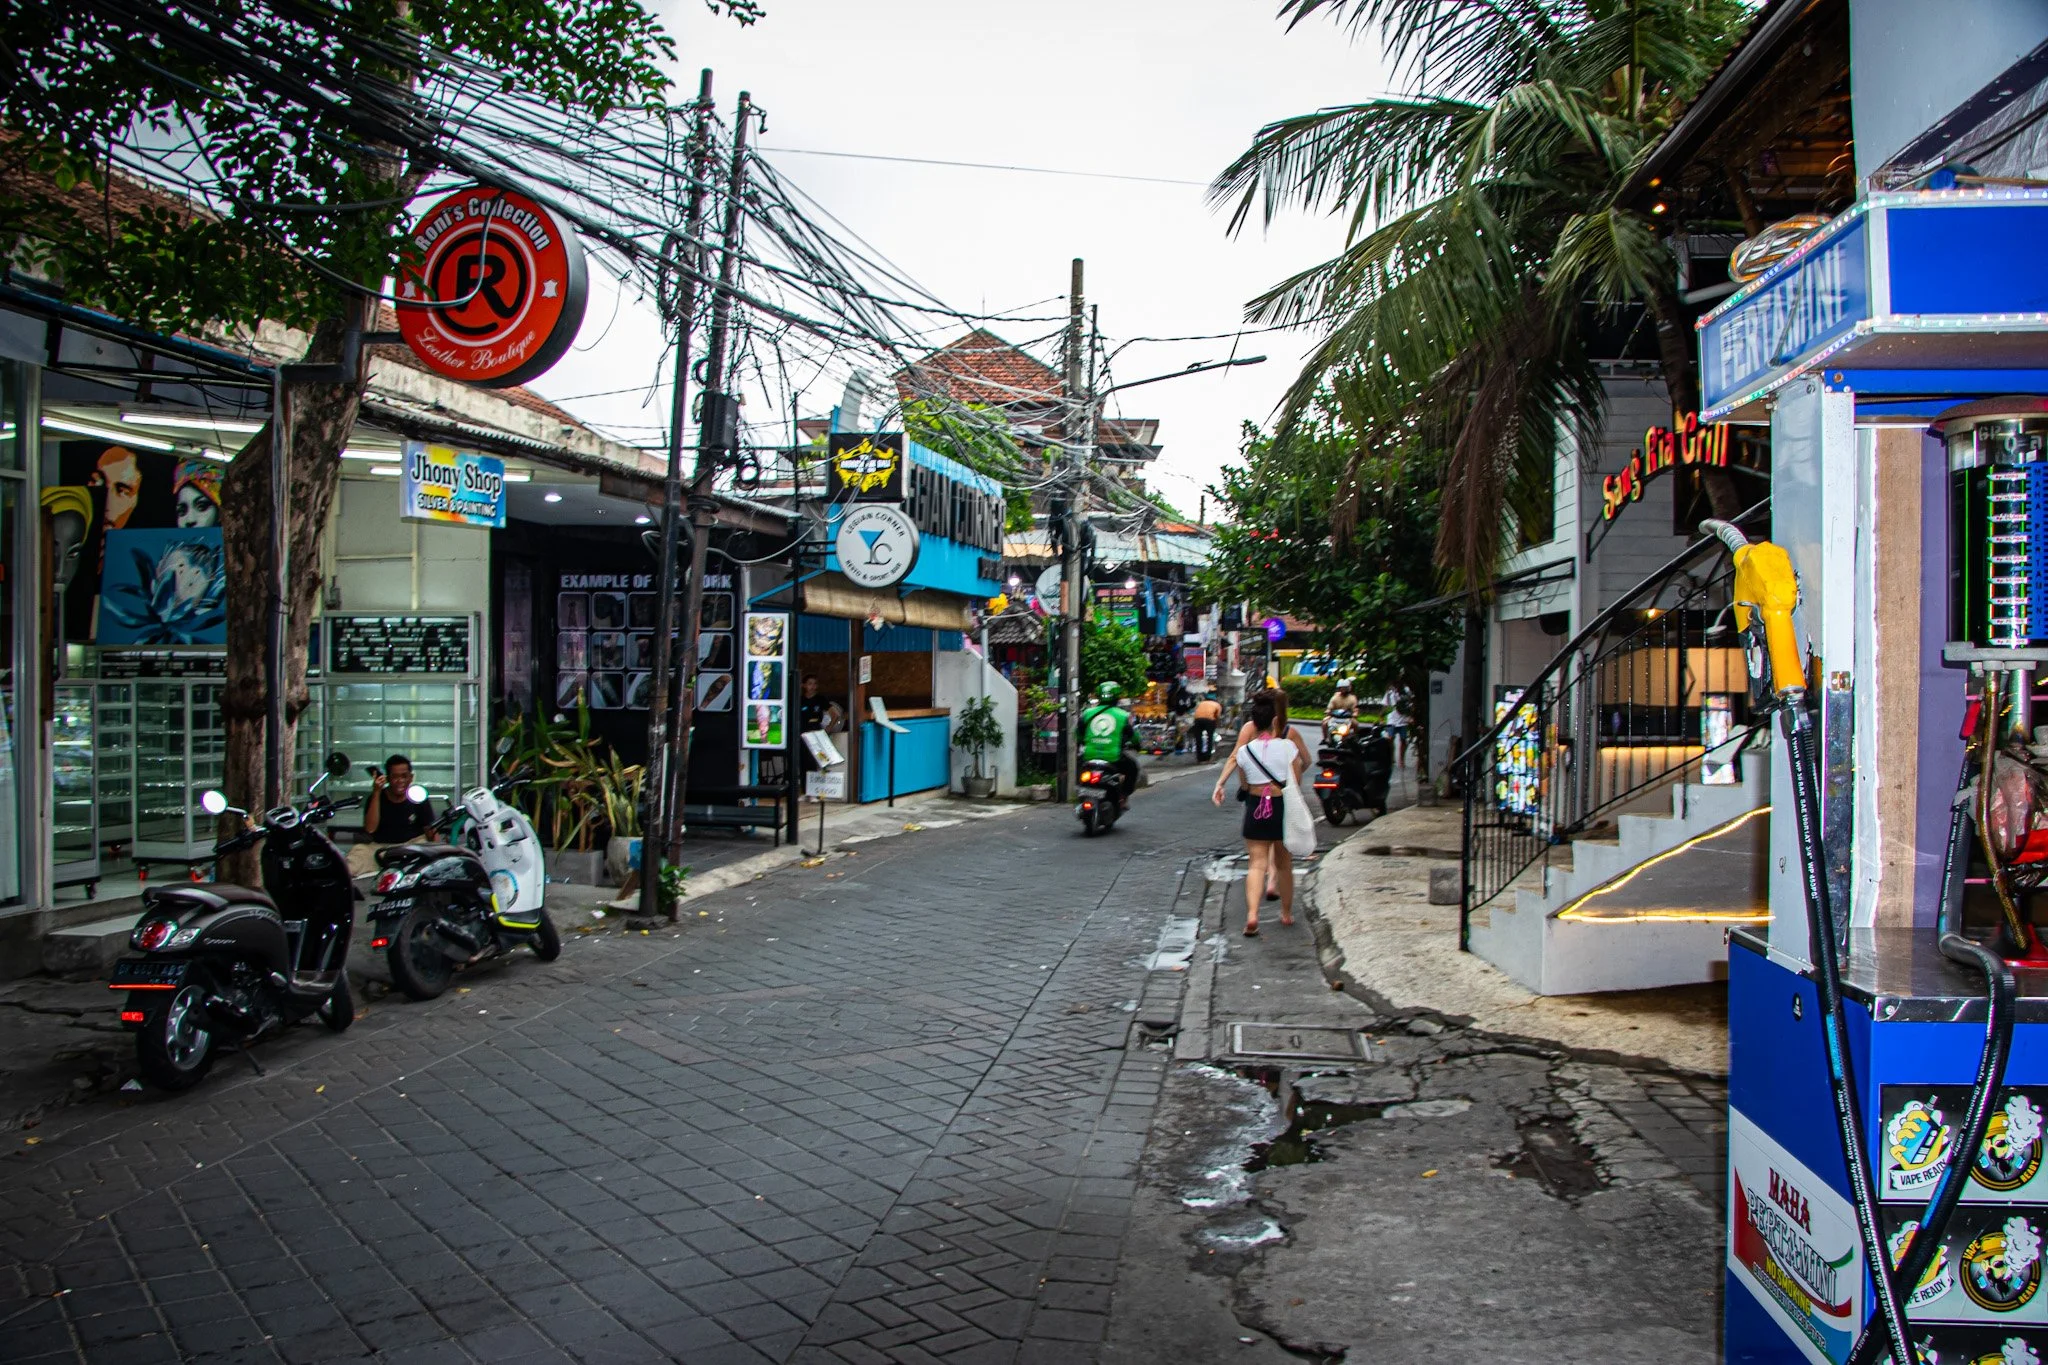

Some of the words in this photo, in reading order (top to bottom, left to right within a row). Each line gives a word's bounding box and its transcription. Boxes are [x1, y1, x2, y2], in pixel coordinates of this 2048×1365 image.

[415, 203, 465, 252] Roni's
[416, 326, 466, 369] Leather
[470, 330, 536, 371] Boutique
[1681, 411, 1730, 468] Grill
[412, 453, 461, 494] Jhony
[464, 463, 501, 501] Shop
[417, 493, 449, 511] SILVER
[457, 499, 497, 517] PAINTING
[875, 512, 906, 538] CORNER
[560, 574, 630, 588] EXAMPLE
[632, 574, 652, 588] OF
[1797, 781, 1806, 796] BAR
[1799, 799, 1808, 814] SAE
[1953, 1132, 1965, 1157] Japan
[1962, 1085, 1981, 1130] Technology
[1900, 1171, 1922, 1186] VAPE
[1923, 1158, 1948, 1182] READY
[2019, 1159, 2040, 1184] READY
[1768, 1167, 1812, 1235] MAHA
[1837, 1089, 1846, 1113] Japan
[1842, 1115, 1854, 1160] Technology
[1850, 1162, 1863, 1201] Hydraulic
[1858, 1203, 1867, 1224] Hose
[1864, 1227, 1873, 1242] DIN
[1875, 1274, 1884, 1288] WP
[1881, 1300, 1892, 1319] BAR
[1887, 1321, 1898, 1340] SAE
[1747, 1187, 1837, 1312] PERTAMINI
[1962, 1239, 1982, 1260] VAPE
[1765, 1255, 1778, 1280] NO
[1777, 1271, 1812, 1317] SMOKING
[1920, 1278, 1948, 1303] READY
[2017, 1281, 2039, 1304] READY
